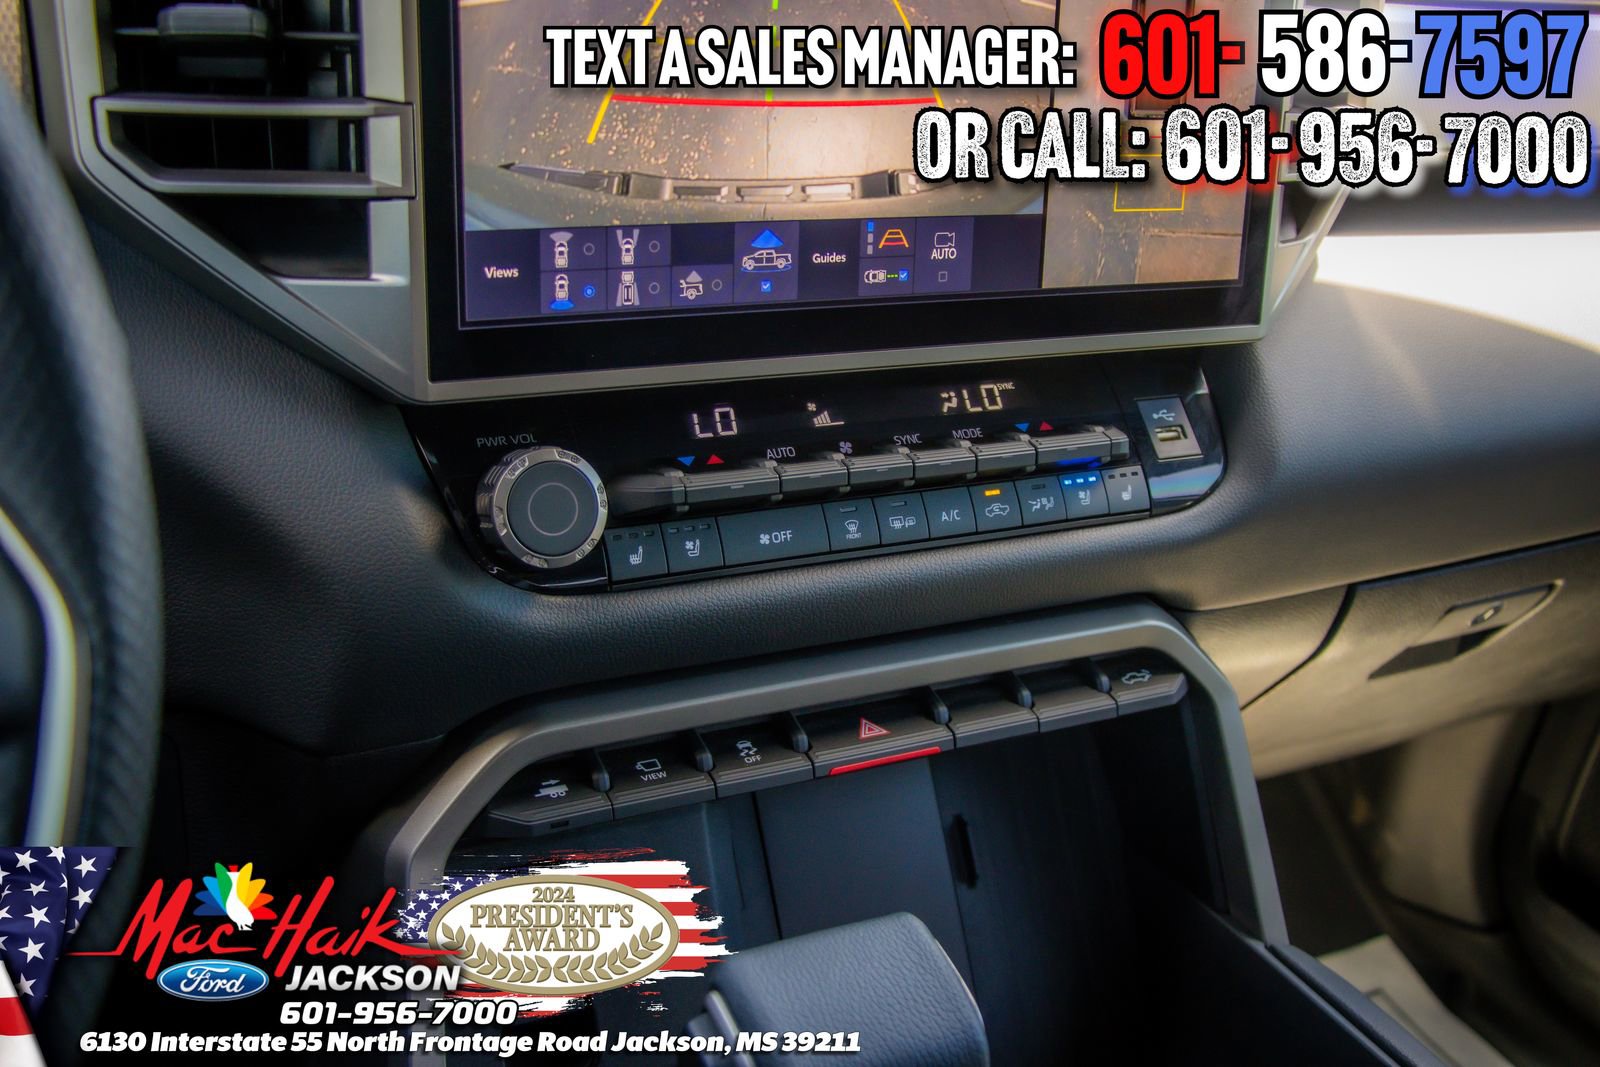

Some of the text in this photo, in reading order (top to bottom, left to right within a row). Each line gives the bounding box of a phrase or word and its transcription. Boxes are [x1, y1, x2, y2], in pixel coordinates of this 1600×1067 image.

[812, 251, 847, 265] Guides
[930, 246, 957, 260] AUTO
[484, 266, 519, 279] Views
[476, 432, 537, 449] PWR VOL
[893, 432, 923, 446] SYNC
[952, 427, 984, 442] MODE
[766, 446, 796, 461] AUTO
[941, 508, 962, 522] A/C
[771, 529, 794, 545] OFF
[845, 531, 863, 541] FRONT
[743, 753, 762, 765] OFF
[640, 770, 667, 783] VIEW
